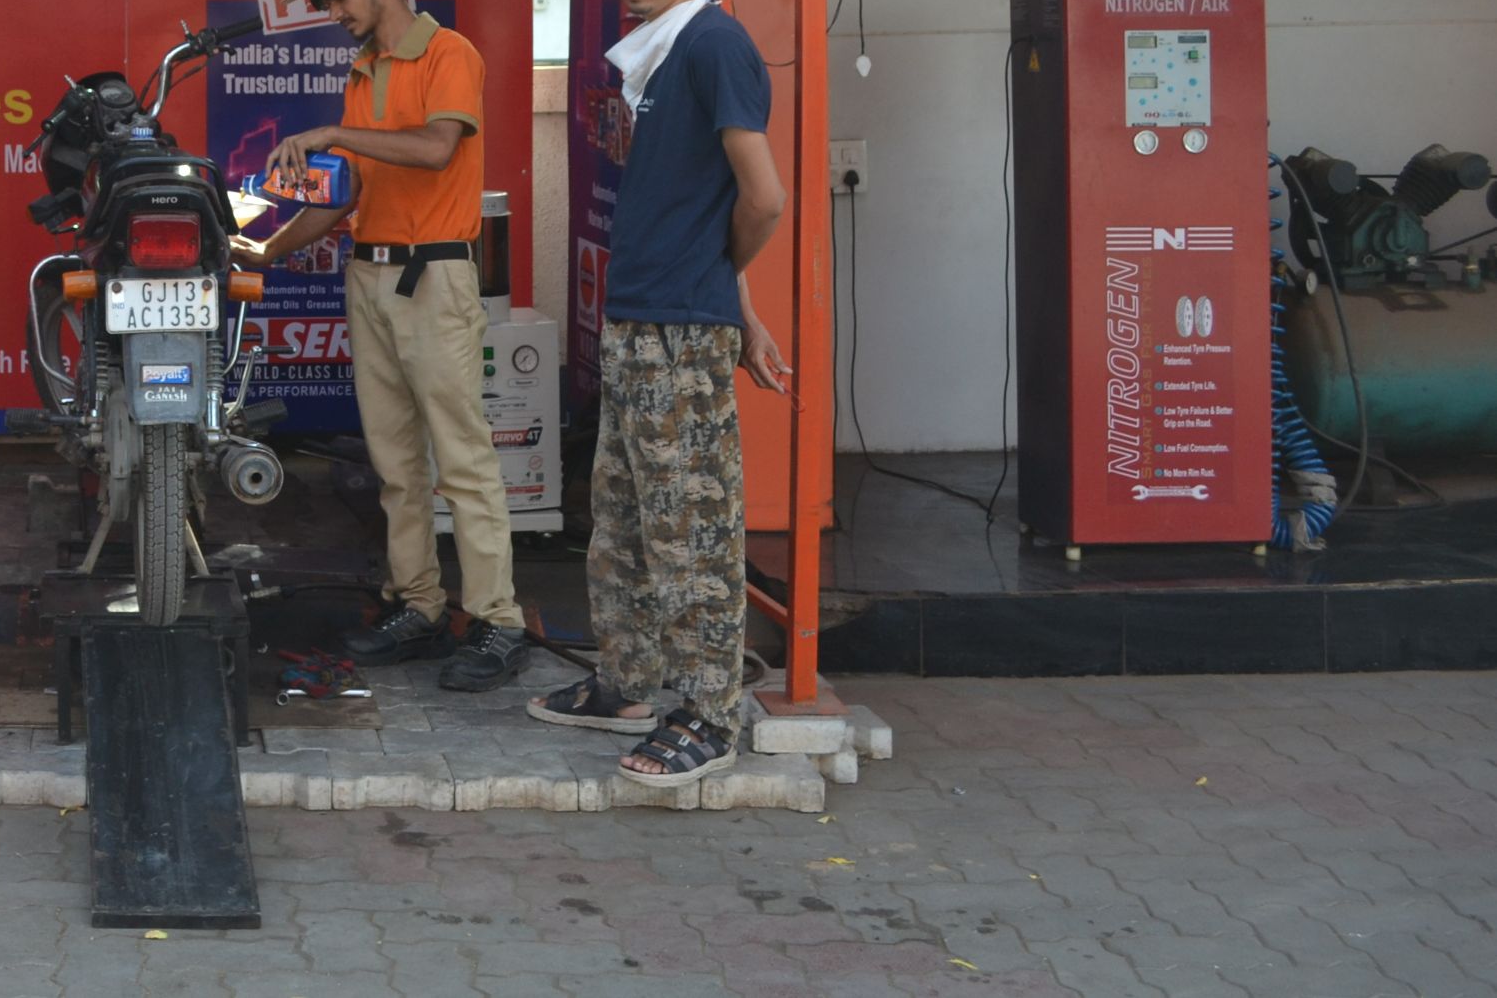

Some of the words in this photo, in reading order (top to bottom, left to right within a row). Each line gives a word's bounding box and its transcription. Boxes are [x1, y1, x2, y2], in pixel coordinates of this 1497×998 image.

[223, 44, 290, 65] India's
[223, 73, 299, 94] Trusted
[142, 281, 196, 303] GJ13
[112, 302, 125, 310] IND
[306, 301, 341, 310] Greases
[127, 305, 211, 328] AC1353
[233, 365, 331, 380] WRLD-CLASS
[1106, 257, 1140, 480] NITROGEN
[493, 432, 524, 443] SERVO
[526, 430, 540, 442] 4T
